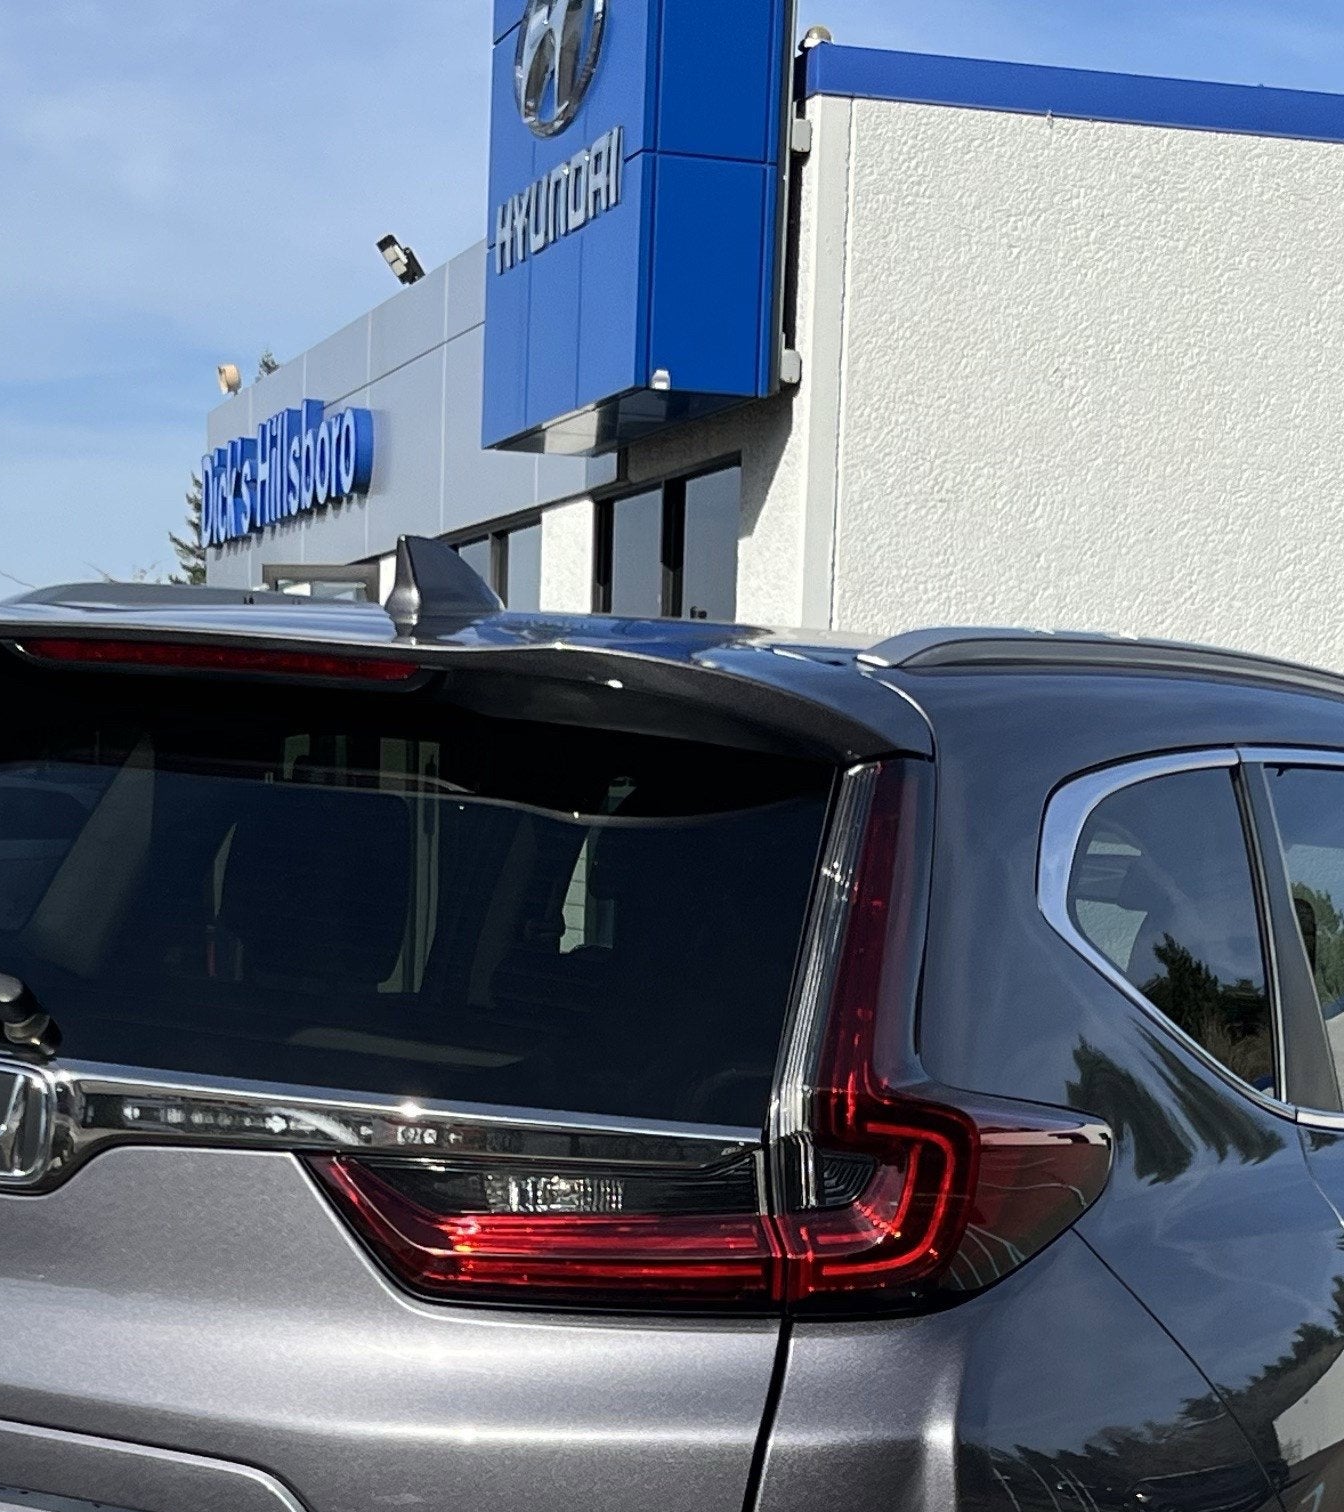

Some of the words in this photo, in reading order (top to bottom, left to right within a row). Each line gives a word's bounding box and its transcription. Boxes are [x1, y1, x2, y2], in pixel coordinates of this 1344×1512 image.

[495, 126, 623, 276] HYUNDAI
[201, 437, 254, 548] Dick's
[256, 399, 362, 528] Hillsboro
